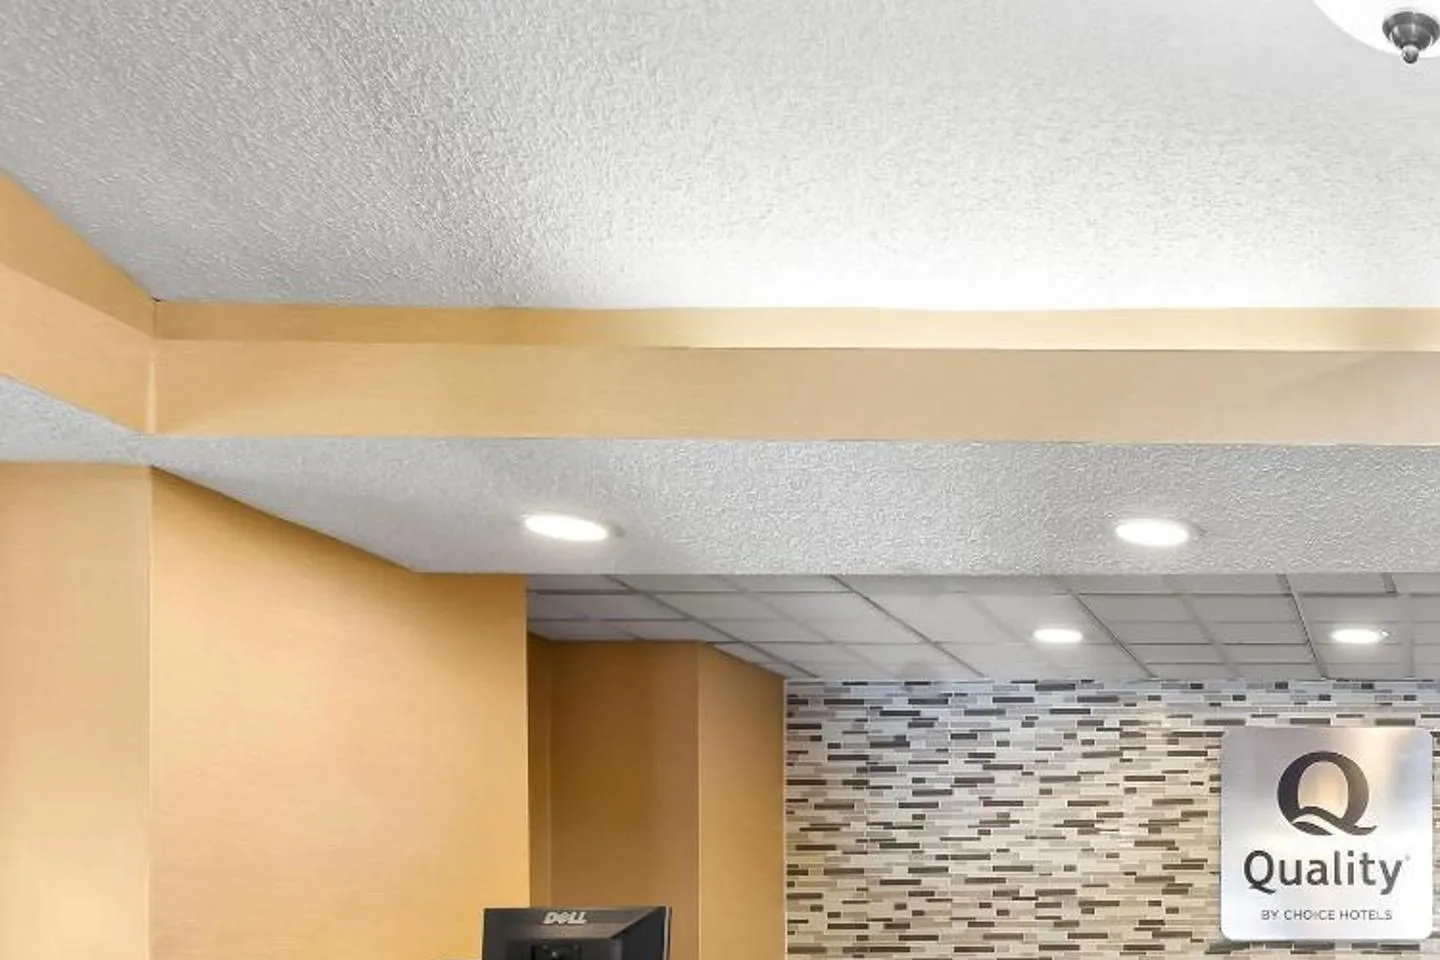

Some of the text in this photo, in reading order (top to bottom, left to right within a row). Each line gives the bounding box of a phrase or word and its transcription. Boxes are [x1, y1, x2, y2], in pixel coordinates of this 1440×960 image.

[1277, 750, 1378, 836] Q
[1243, 850, 1403, 895] Quality
[543, 911, 588, 925] DELL
[1261, 909, 1393, 921] BY CHOICE HOTELS
